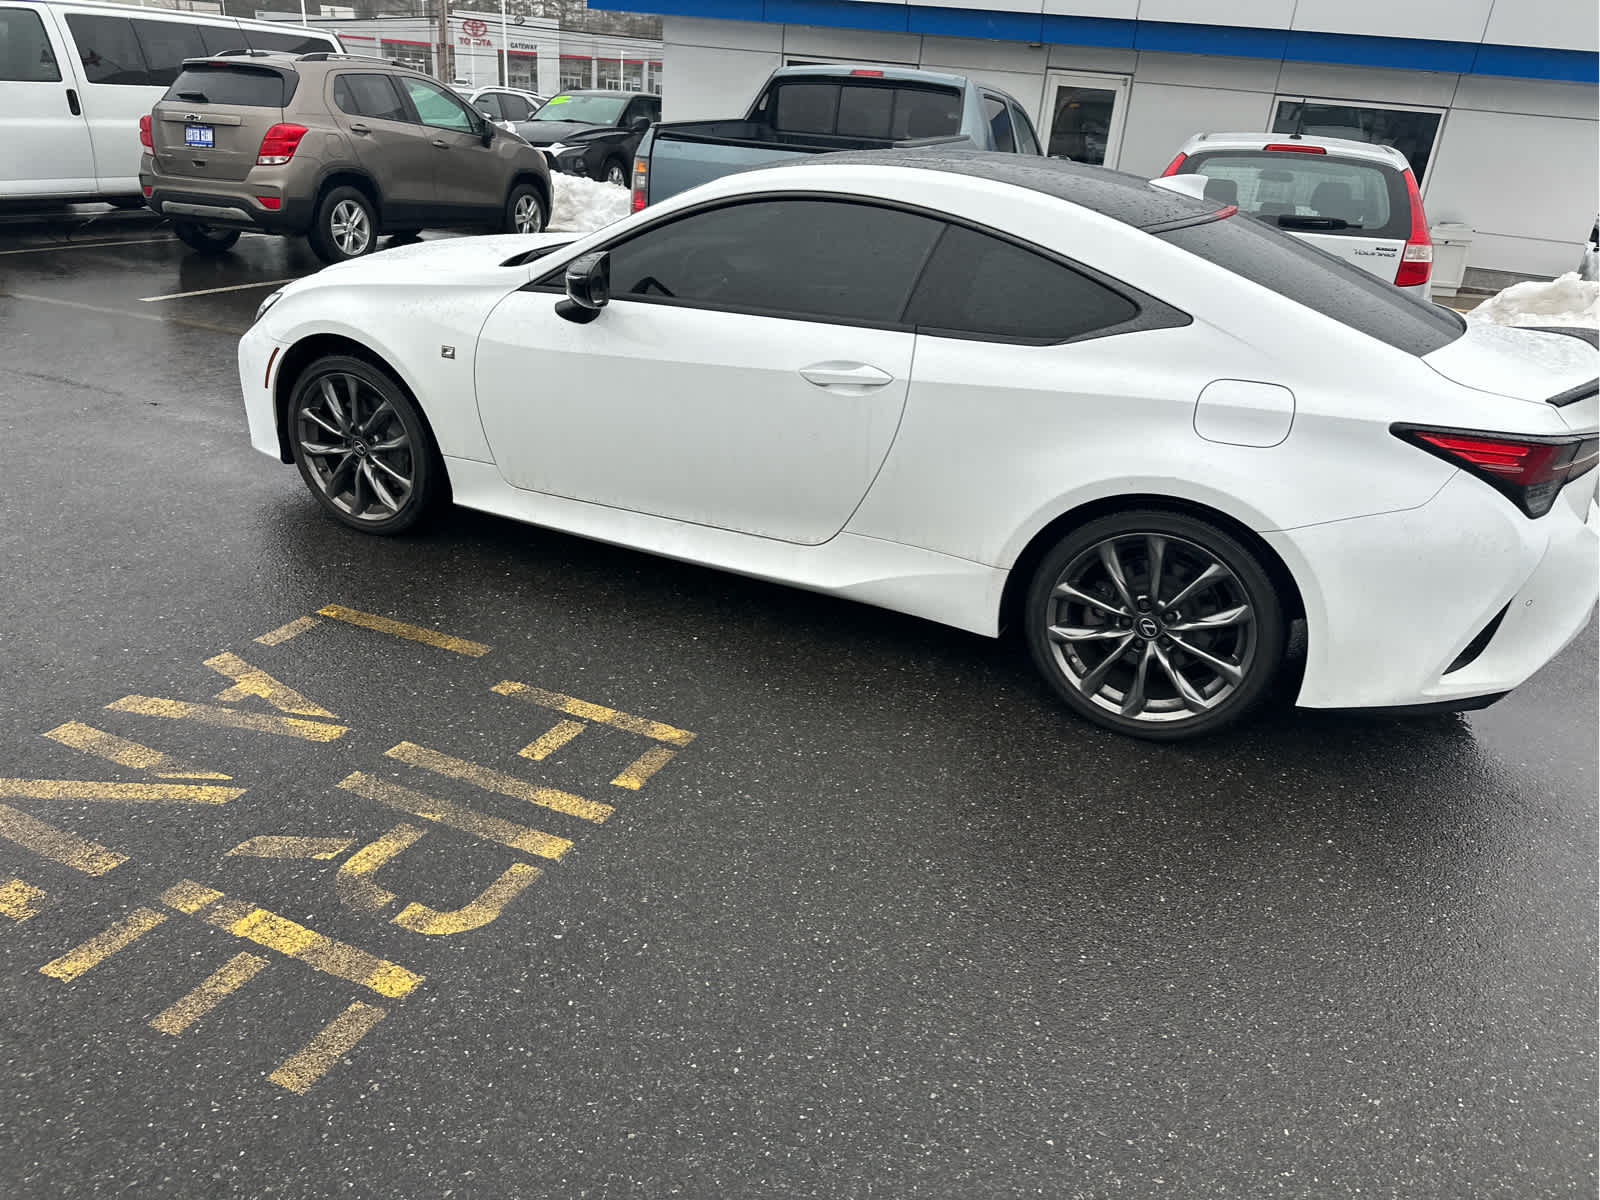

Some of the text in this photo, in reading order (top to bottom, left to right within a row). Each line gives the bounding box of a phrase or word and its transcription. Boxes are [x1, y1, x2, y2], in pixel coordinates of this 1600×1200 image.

[510, 42, 538, 50] GATEWAY
[0, 603, 492, 921] LAN
[39, 680, 698, 1095] FIRE
